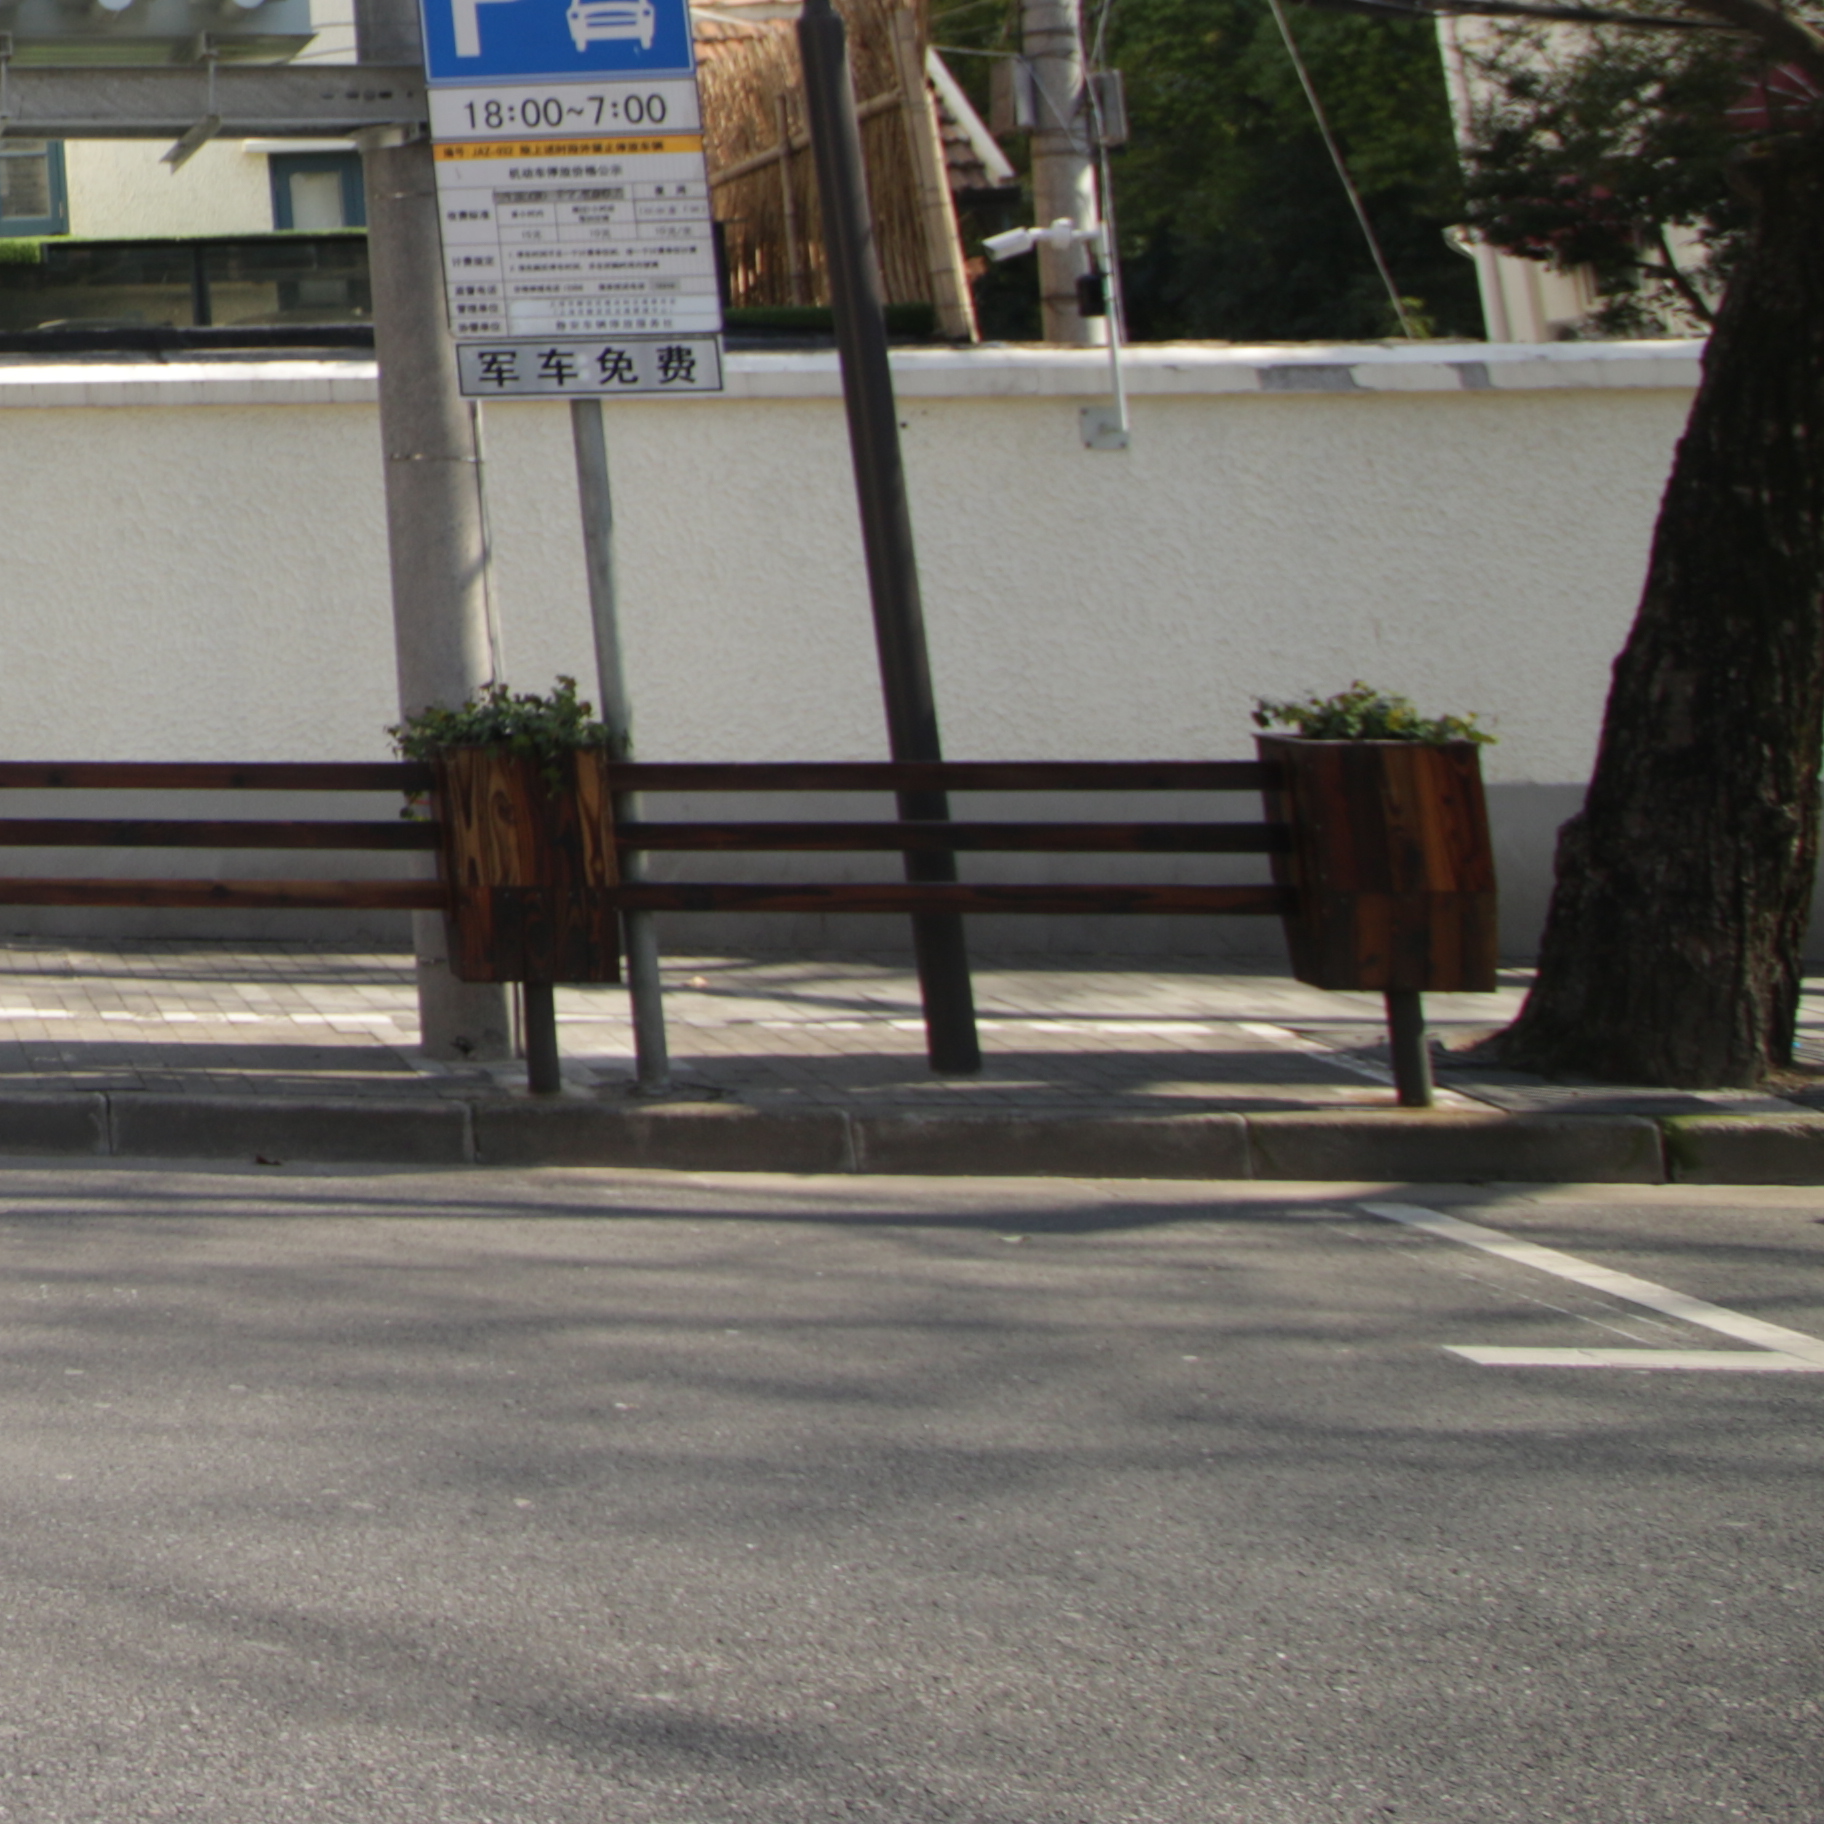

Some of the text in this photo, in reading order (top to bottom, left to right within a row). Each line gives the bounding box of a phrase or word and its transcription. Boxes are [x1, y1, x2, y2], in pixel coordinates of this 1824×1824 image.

[462, 92, 668, 130] 18:00~7:00
[477, 345, 698, 387] 军车免费
